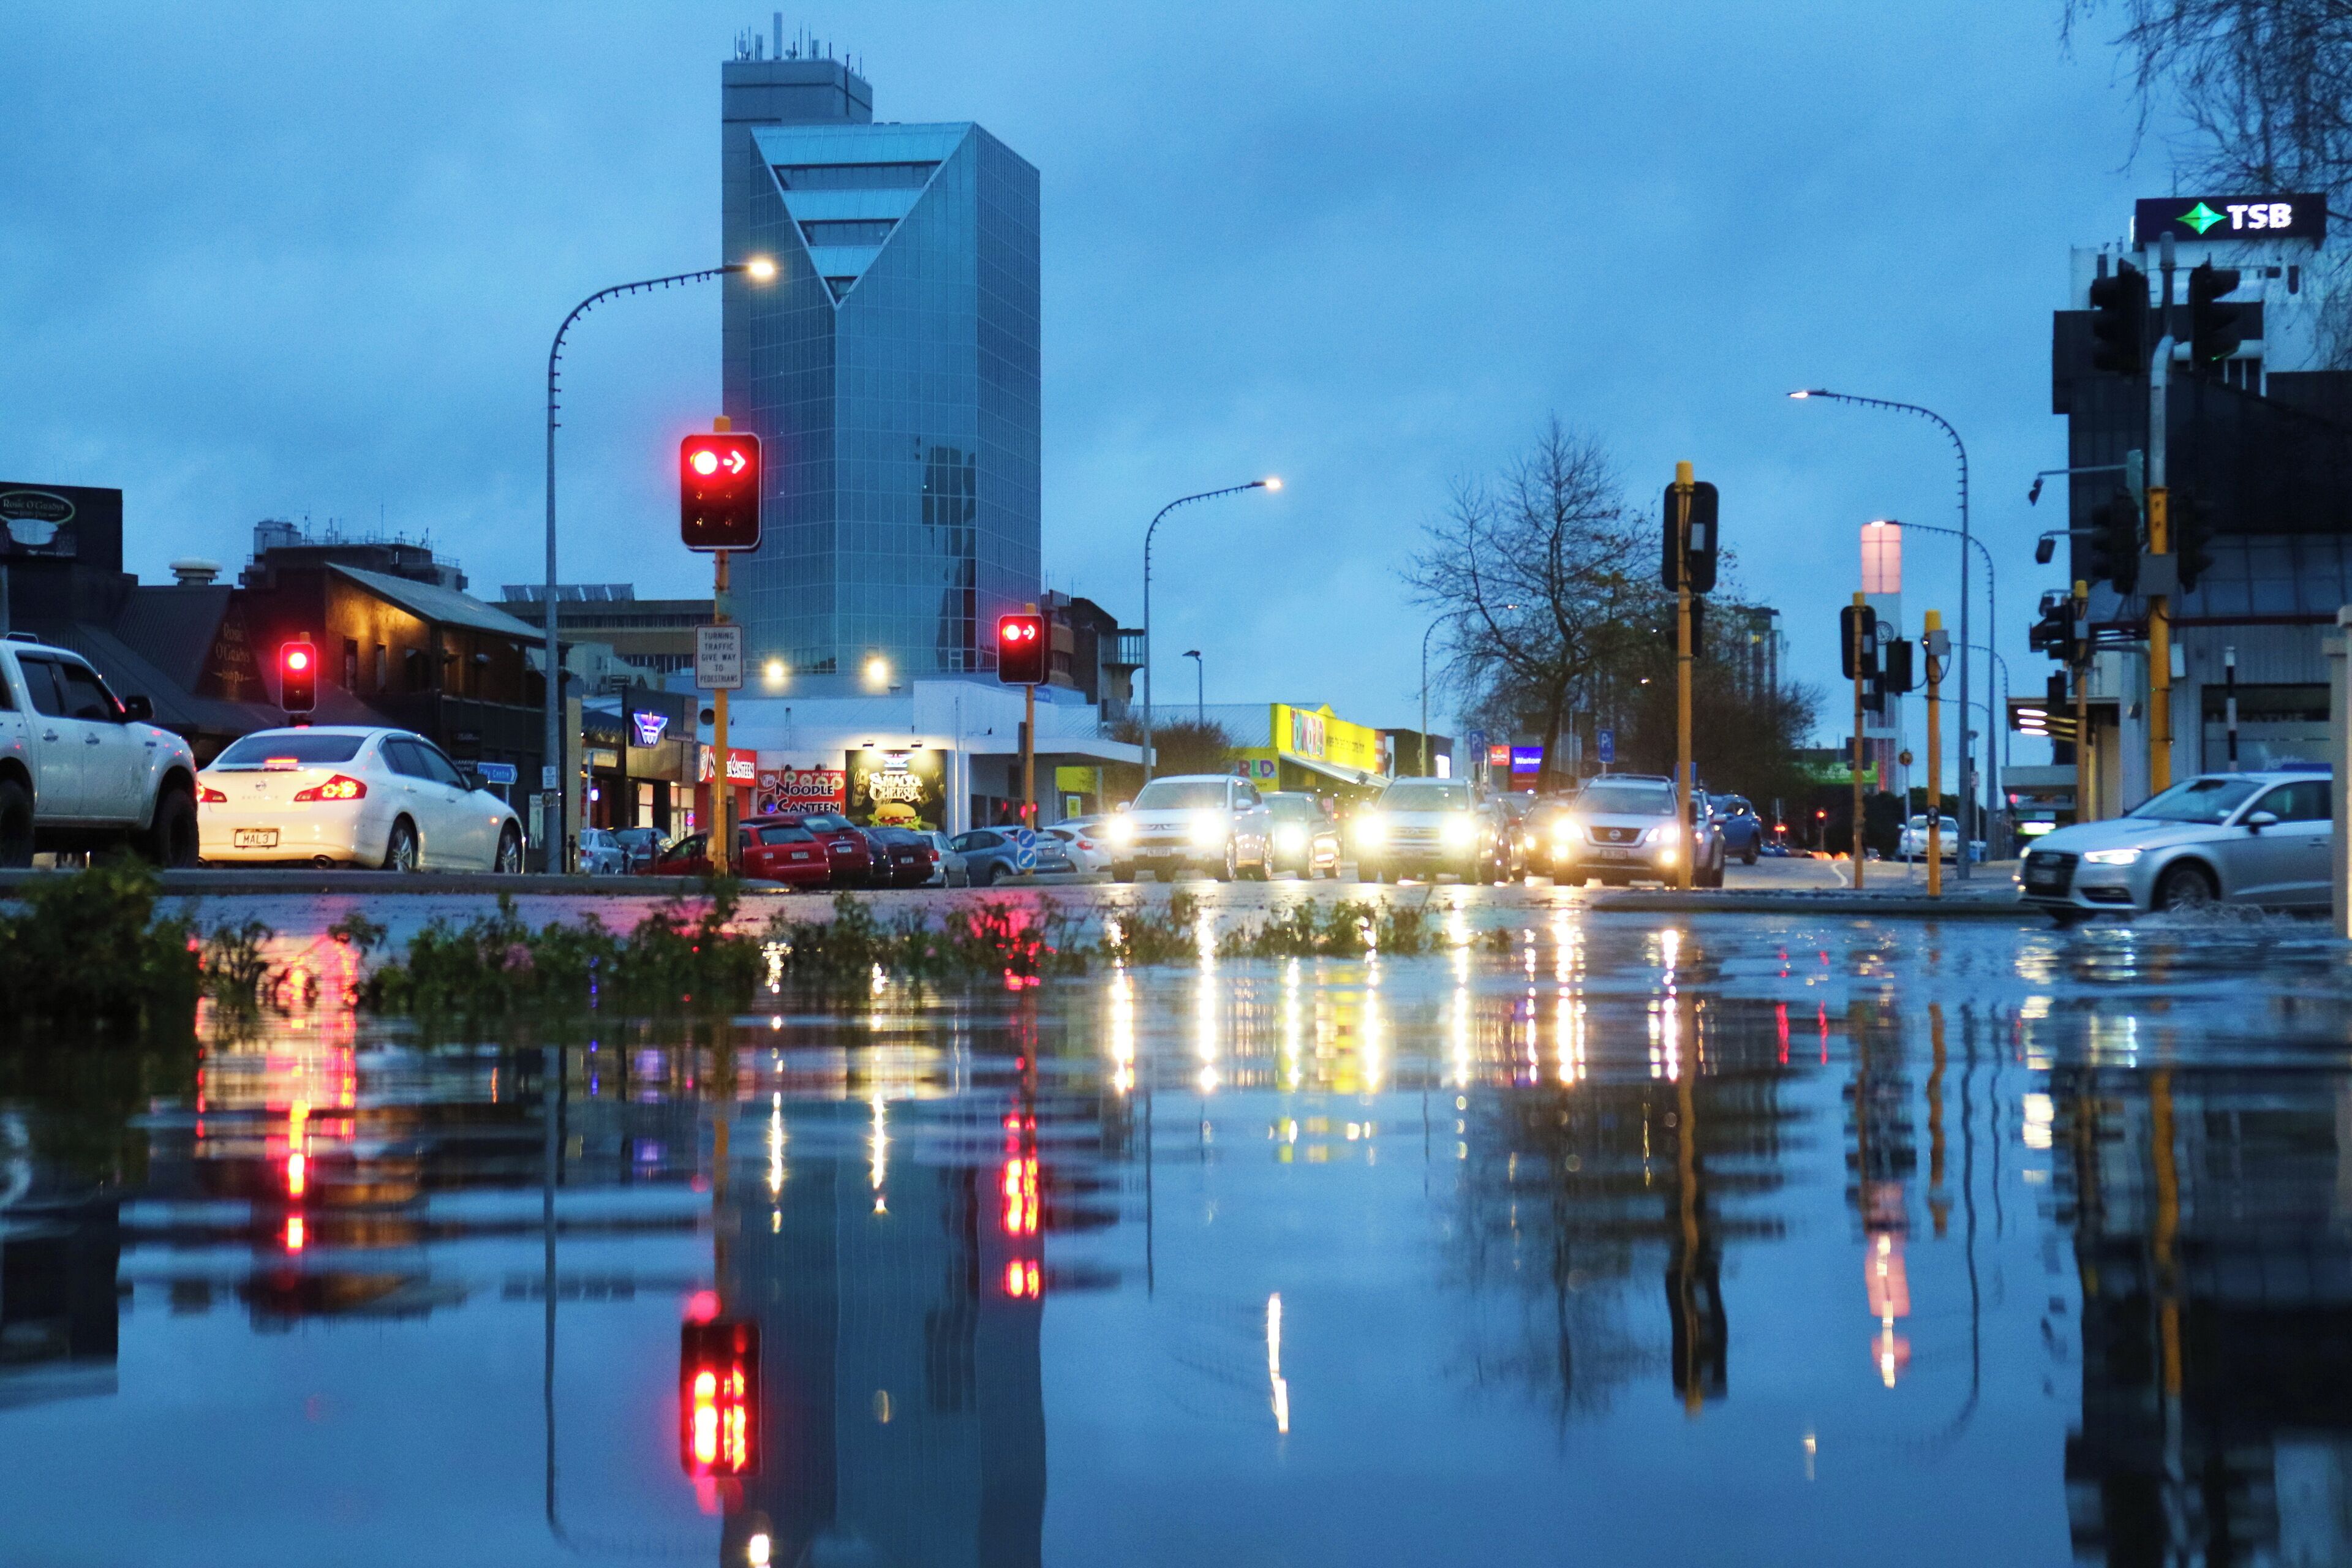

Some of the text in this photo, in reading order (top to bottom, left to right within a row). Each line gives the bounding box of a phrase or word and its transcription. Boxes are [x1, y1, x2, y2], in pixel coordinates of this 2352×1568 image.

[2226, 203, 2292, 230] TSB
[700, 674, 737, 683] PEDESTRIANS
[731, 752, 755, 779] CANTEEN
[492, 769, 510, 779] Centre
[775, 781, 834, 796] NOODLE
[777, 797, 840, 813] CANTEEN
[243, 834, 269, 844] MAL3
